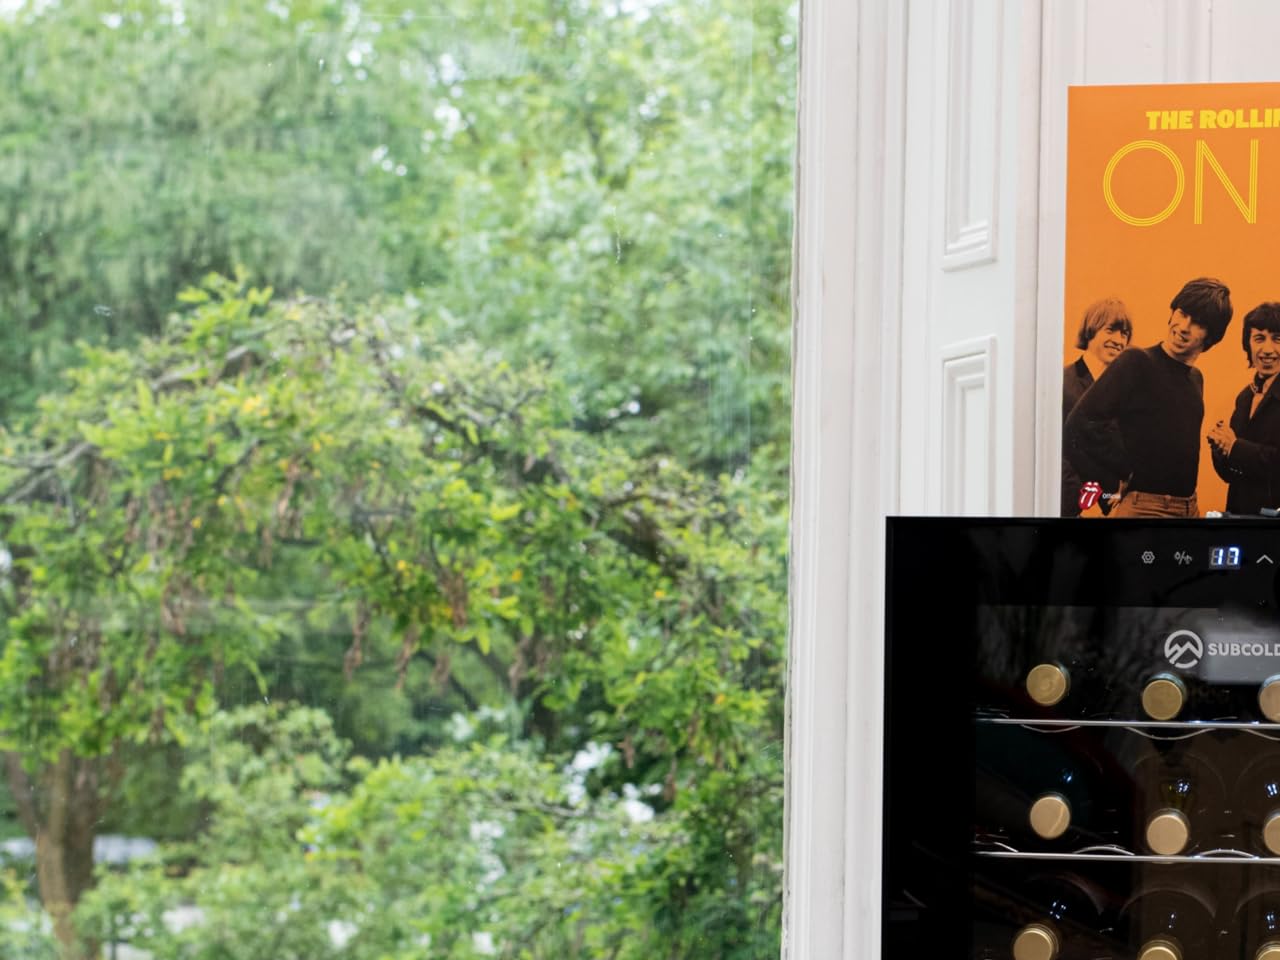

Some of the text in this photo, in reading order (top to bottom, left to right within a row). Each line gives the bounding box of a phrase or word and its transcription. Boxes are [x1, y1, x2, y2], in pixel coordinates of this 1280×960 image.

[1146, 110, 1194, 130] THE
[1103, 138, 1258, 227] ON
[1216, 547, 1240, 566] 17
